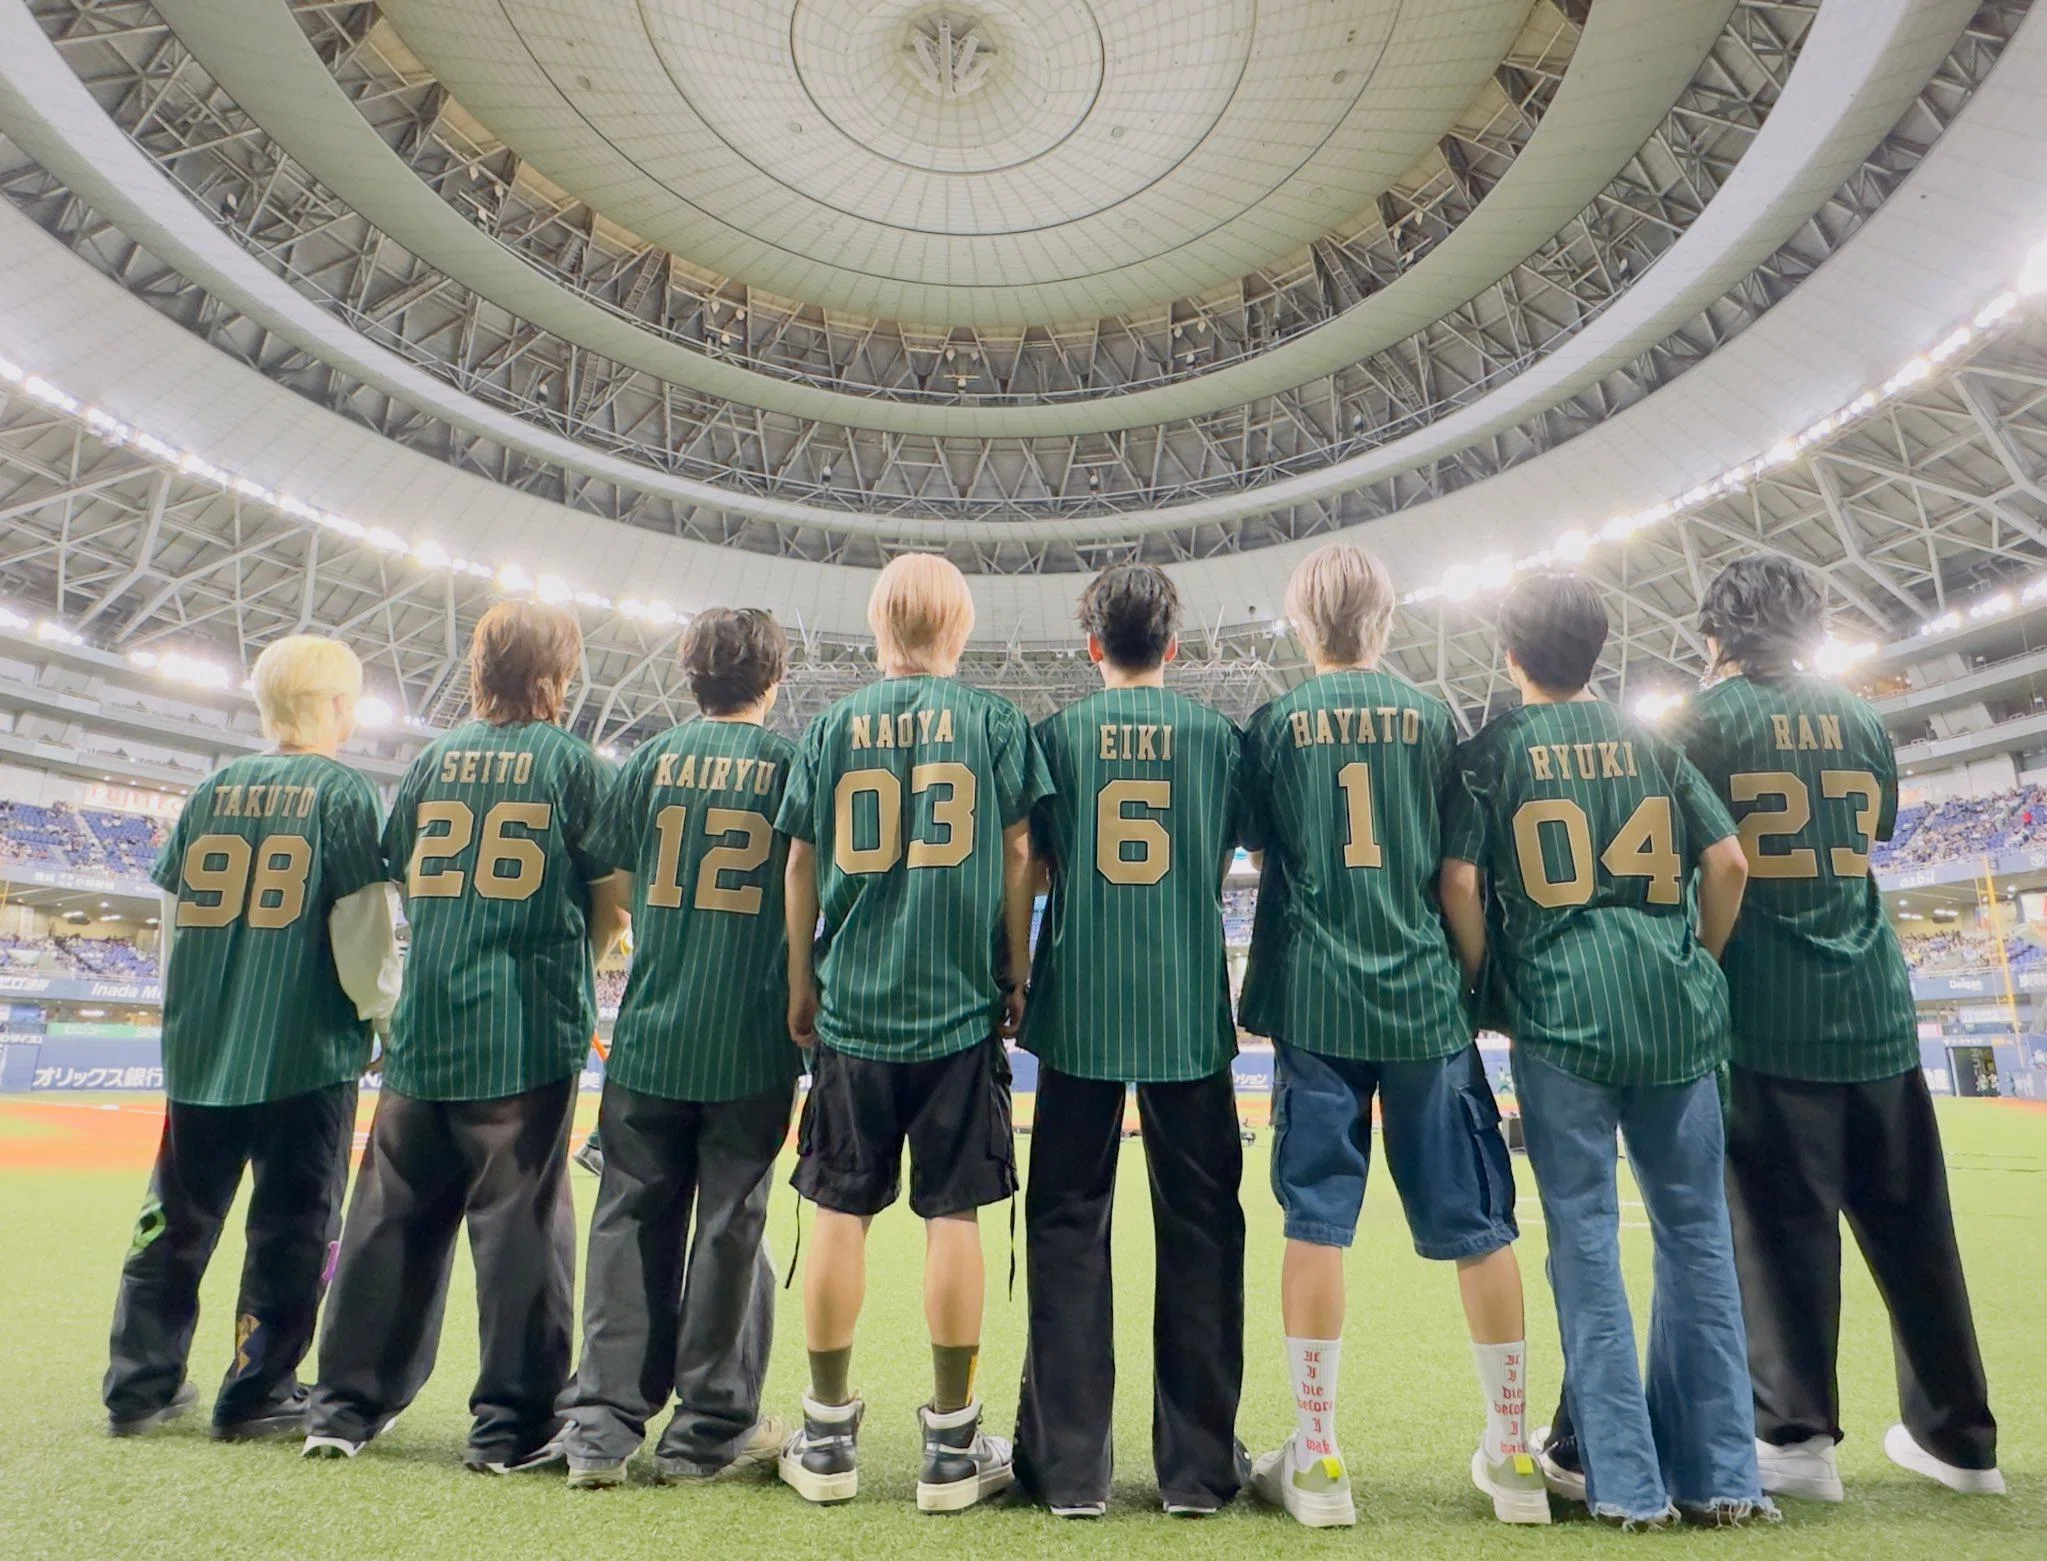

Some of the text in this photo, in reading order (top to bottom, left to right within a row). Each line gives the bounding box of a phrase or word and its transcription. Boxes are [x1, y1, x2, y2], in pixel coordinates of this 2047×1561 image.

[852, 709, 953, 751] NAOYA
[1099, 724, 1172, 761] EIKI
[1290, 707, 1420, 749] HAYATO
[1771, 714, 1844, 751] RAN
[441, 750, 534, 785] SEITO
[655, 752, 776, 796] KAIRYU
[1528, 742, 1638, 781] RYUKI
[213, 785, 316, 818] TAKUTO
[834, 761, 977, 875] 03
[1338, 762, 1381, 869] 1
[1096, 779, 1171, 886] 6
[1730, 770, 1881, 879] 23
[408, 800, 554, 901] 26
[647, 805, 773, 915] 12
[1512, 796, 1682, 909] 04
[175, 833, 313, 929] 98
[91, 983, 138, 998] Inada
[32, 1067, 164, 1088] オリックス銀行
[1302, 1382, 1324, 1397] die
